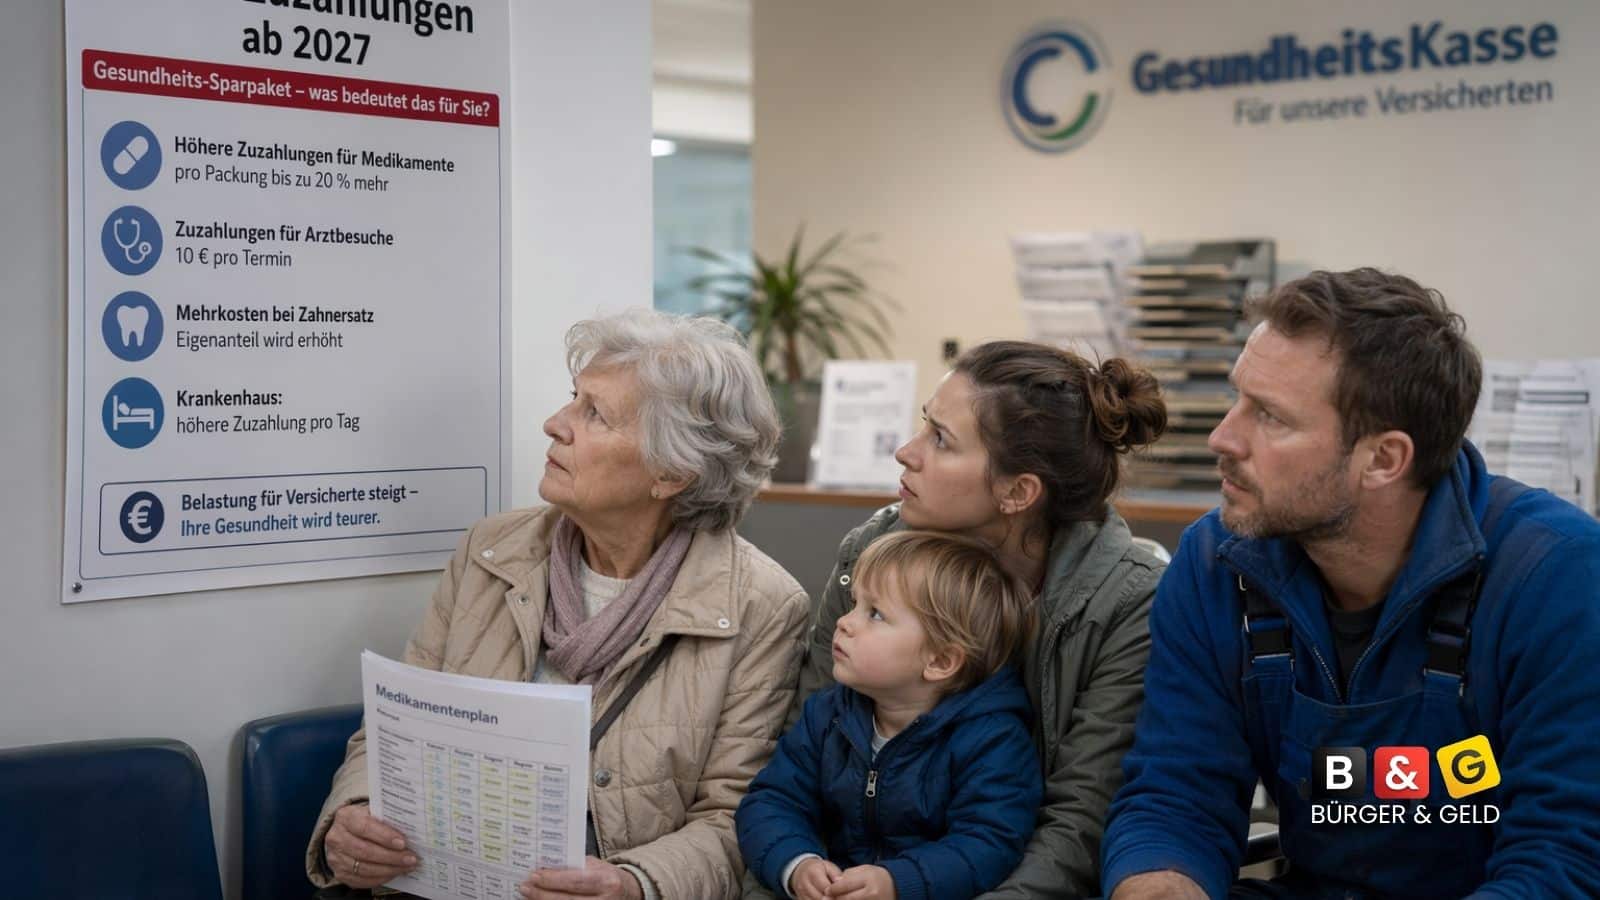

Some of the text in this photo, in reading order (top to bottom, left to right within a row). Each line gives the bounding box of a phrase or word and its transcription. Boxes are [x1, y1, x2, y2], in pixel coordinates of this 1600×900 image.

[242, 20, 371, 65] ab 2027
[93, 60, 292, 98] Gesundheits-Sparpaket
[308, 86, 338, 102] was
[342, 86, 408, 109] bedeutet
[411, 94, 435, 112] das
[439, 97, 459, 114] für
[462, 101, 491, 117] Sie?
[1234, 79, 1554, 125] Für unsere Versicherten
[174, 136, 455, 172] Höhere Zuzahlungen für Medikamente
[175, 164, 389, 191] pro Packung bis zu 20 % mehr
[175, 220, 394, 246] Zuzahlungen für Arztbesuche
[175, 247, 292, 269] 10 € pro Termin
[176, 304, 375, 323] Mehrkosten bei Zahnersatz
[176, 331, 344, 351] Eigenanteil wird erhöht
[176, 390, 283, 407] Krankenhaus:
[176, 412, 361, 434] höhere Zuzahlung pro Tag
[181, 491, 257, 511] Belastung
[260, 489, 283, 506] für
[286, 486, 366, 505] Versicherte
[368, 484, 407, 503] steigt
[181, 511, 381, 537] Ihre Gesundheit wird teurer.
[375, 683, 499, 725] Medikamentenplan
